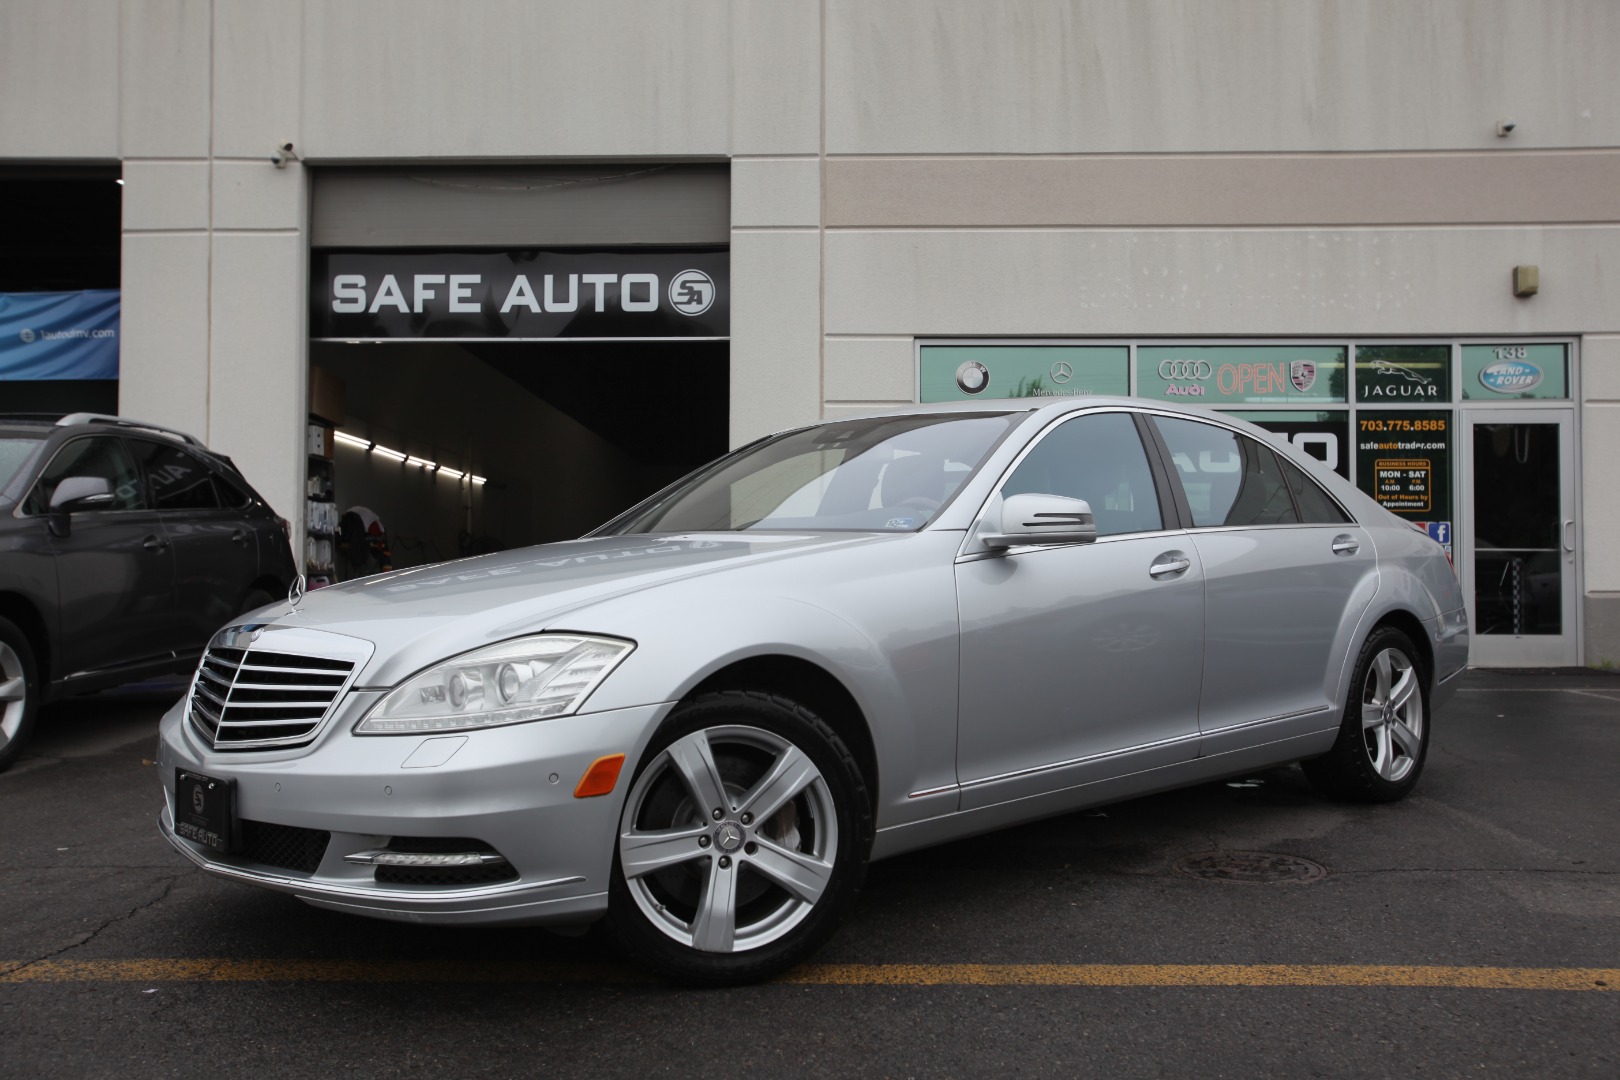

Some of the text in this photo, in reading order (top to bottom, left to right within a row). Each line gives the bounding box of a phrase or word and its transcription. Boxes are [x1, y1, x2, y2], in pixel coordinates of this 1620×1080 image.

[332, 273, 659, 313] SAFE AUTO
[1494, 346, 1527, 359] 138
[1493, 366, 1523, 375] LAND
[1217, 362, 1286, 395] OPEN
[1496, 375, 1534, 385] ROVER
[1165, 383, 1205, 396] Audi
[1364, 385, 1437, 398] JAGUAR
[1360, 420, 1446, 431] 703.775.8585
[1360, 441, 1446, 450] safeautotrader.com
[1379, 470, 1401, 478] MON
[1408, 470, 1426, 478] SAT
[1420, 494, 1428, 502] by
